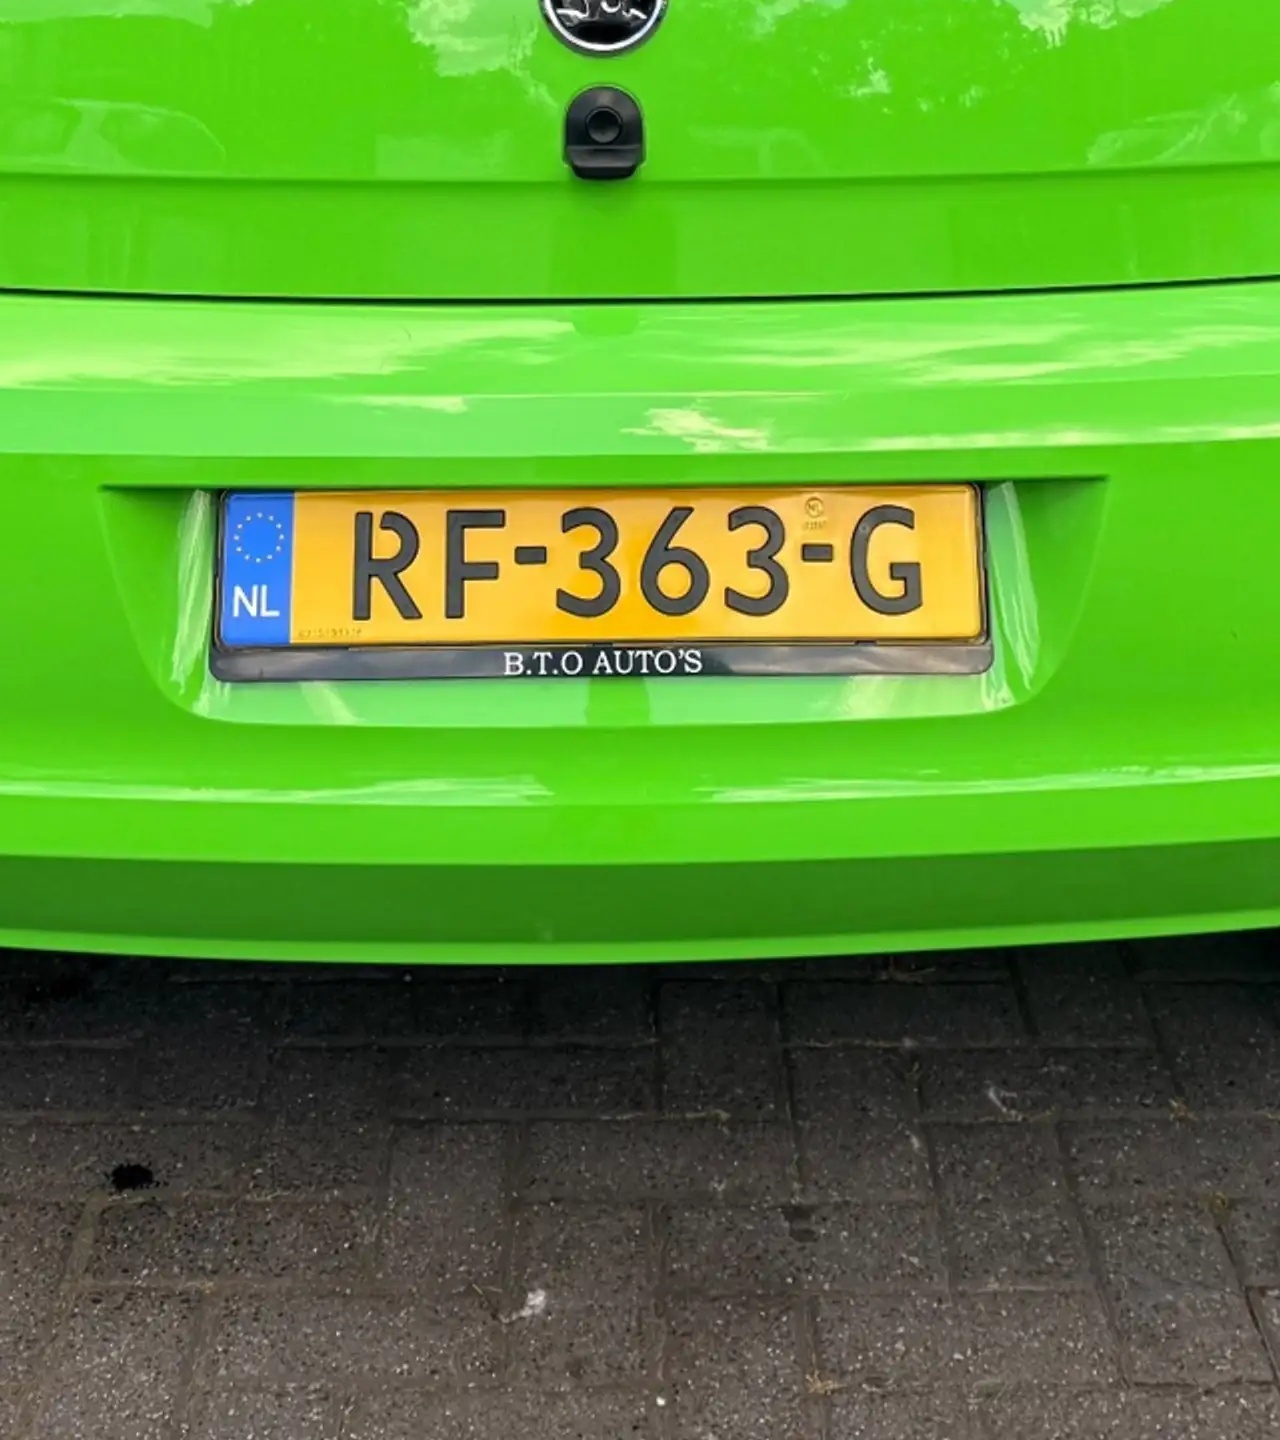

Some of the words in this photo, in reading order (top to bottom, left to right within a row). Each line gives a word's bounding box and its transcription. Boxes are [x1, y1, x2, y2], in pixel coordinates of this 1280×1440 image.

[352, 504, 923, 621] RF-363-G
[233, 585, 280, 618] NL
[503, 651, 583, 676] B.T.O
[592, 648, 703, 675] AUTO'S
